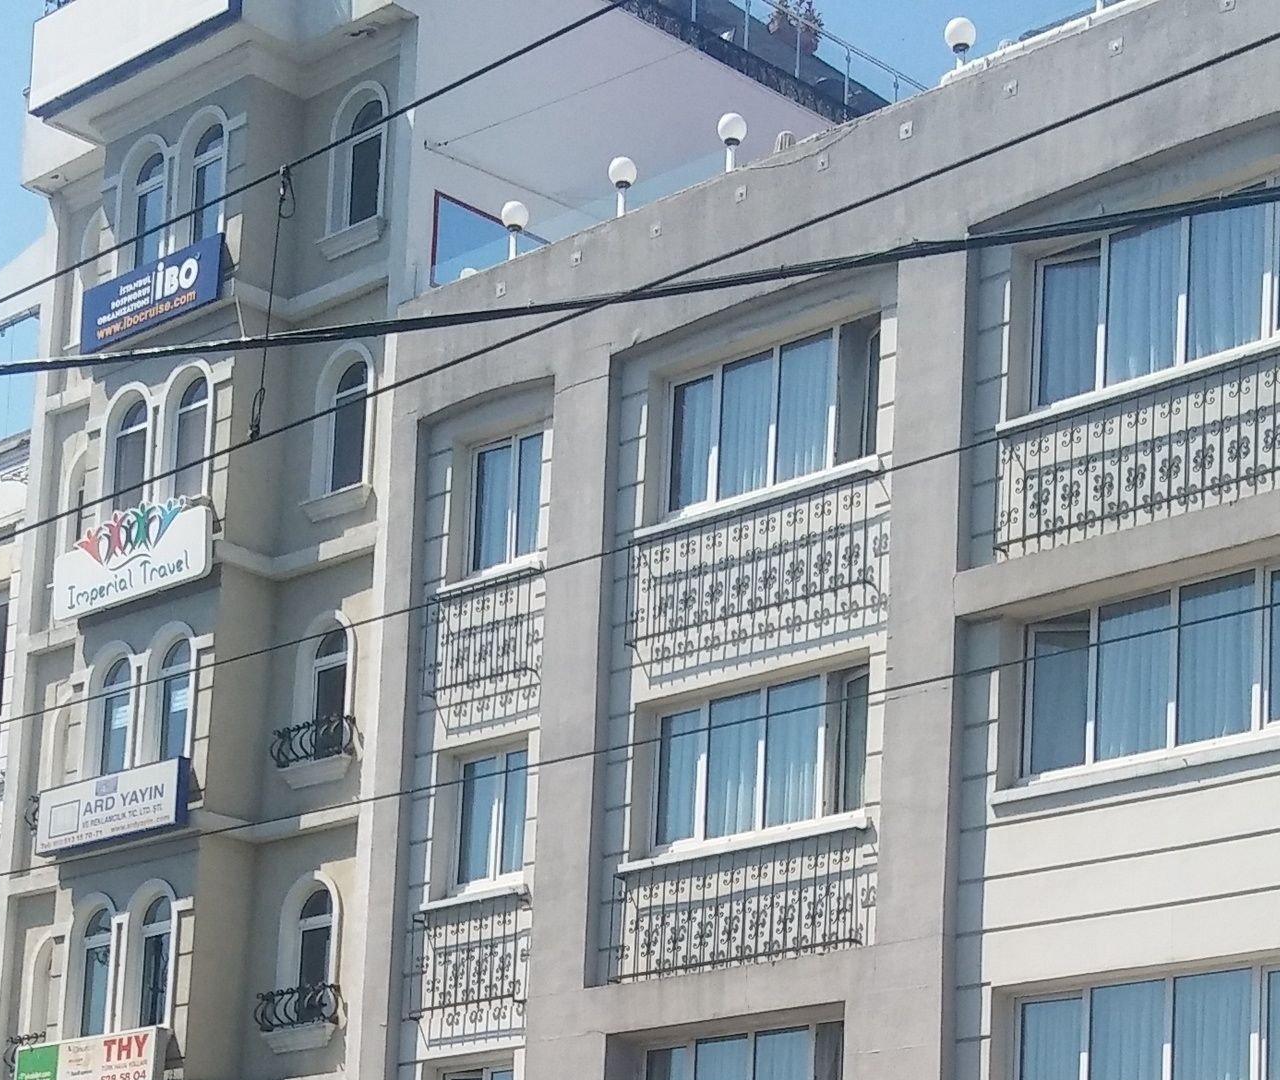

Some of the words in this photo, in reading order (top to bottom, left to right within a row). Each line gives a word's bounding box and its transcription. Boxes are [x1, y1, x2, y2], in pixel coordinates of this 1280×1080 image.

[96, 290, 196, 339] www.ibocruise.com
[68, 569, 133, 609] Imperial
[140, 549, 190, 585] Travel
[83, 797, 115, 816] ARD
[120, 783, 165, 807] YAYIN
[103, 1034, 149, 1062] THY
[133, 1070, 147, 1080] 04
